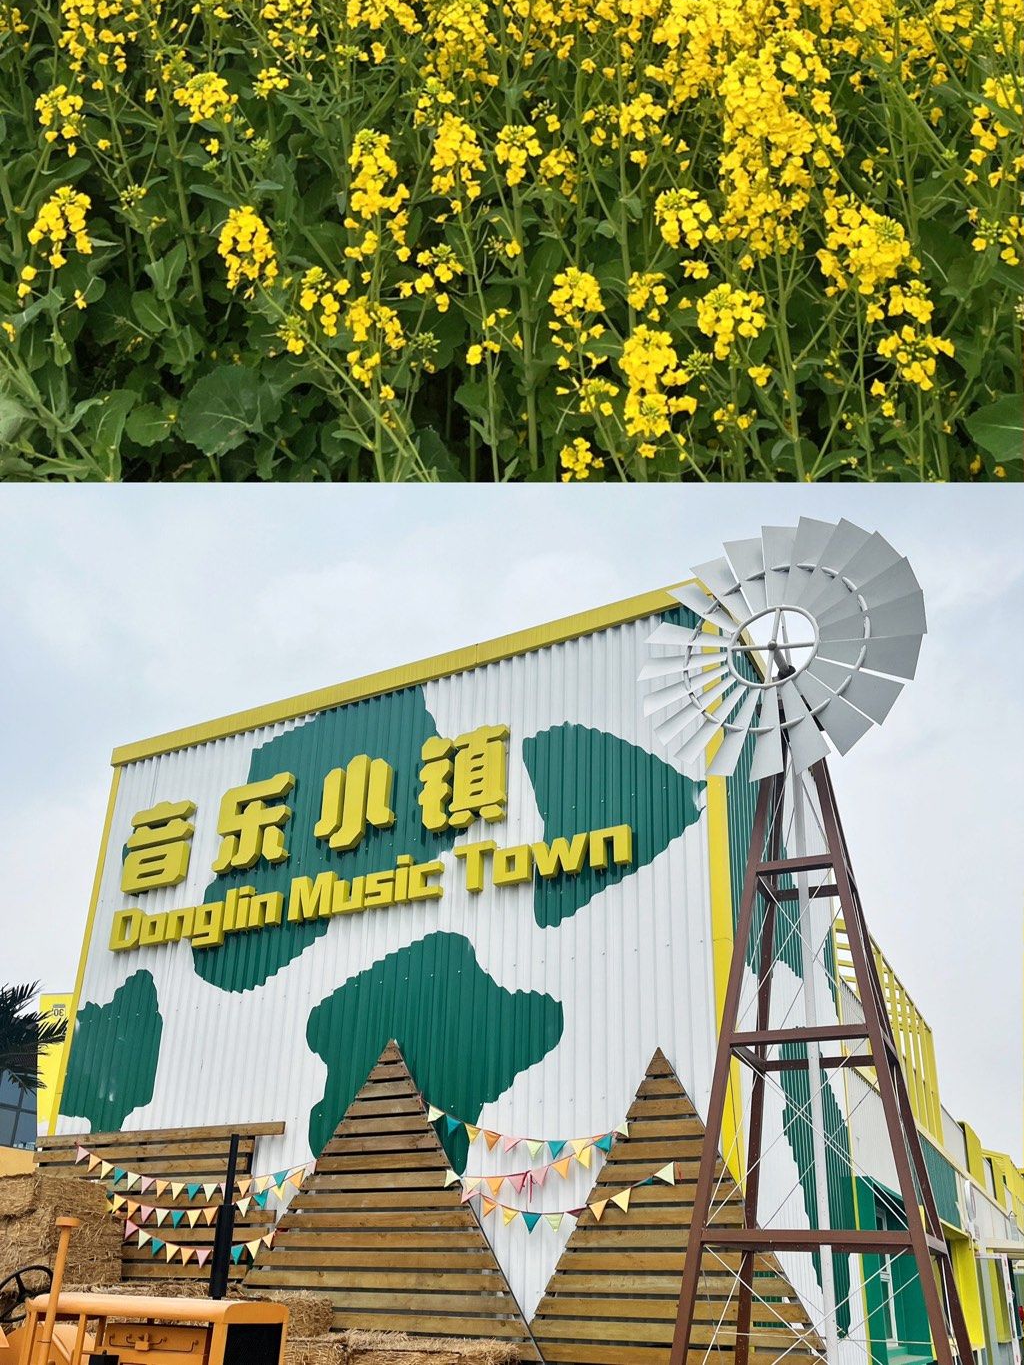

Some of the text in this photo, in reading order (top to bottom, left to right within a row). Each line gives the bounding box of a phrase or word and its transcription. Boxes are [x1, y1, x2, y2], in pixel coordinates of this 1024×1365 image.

[120, 724, 511, 895] 音乐小镇
[108, 823, 633, 952] Donglin Music Town
